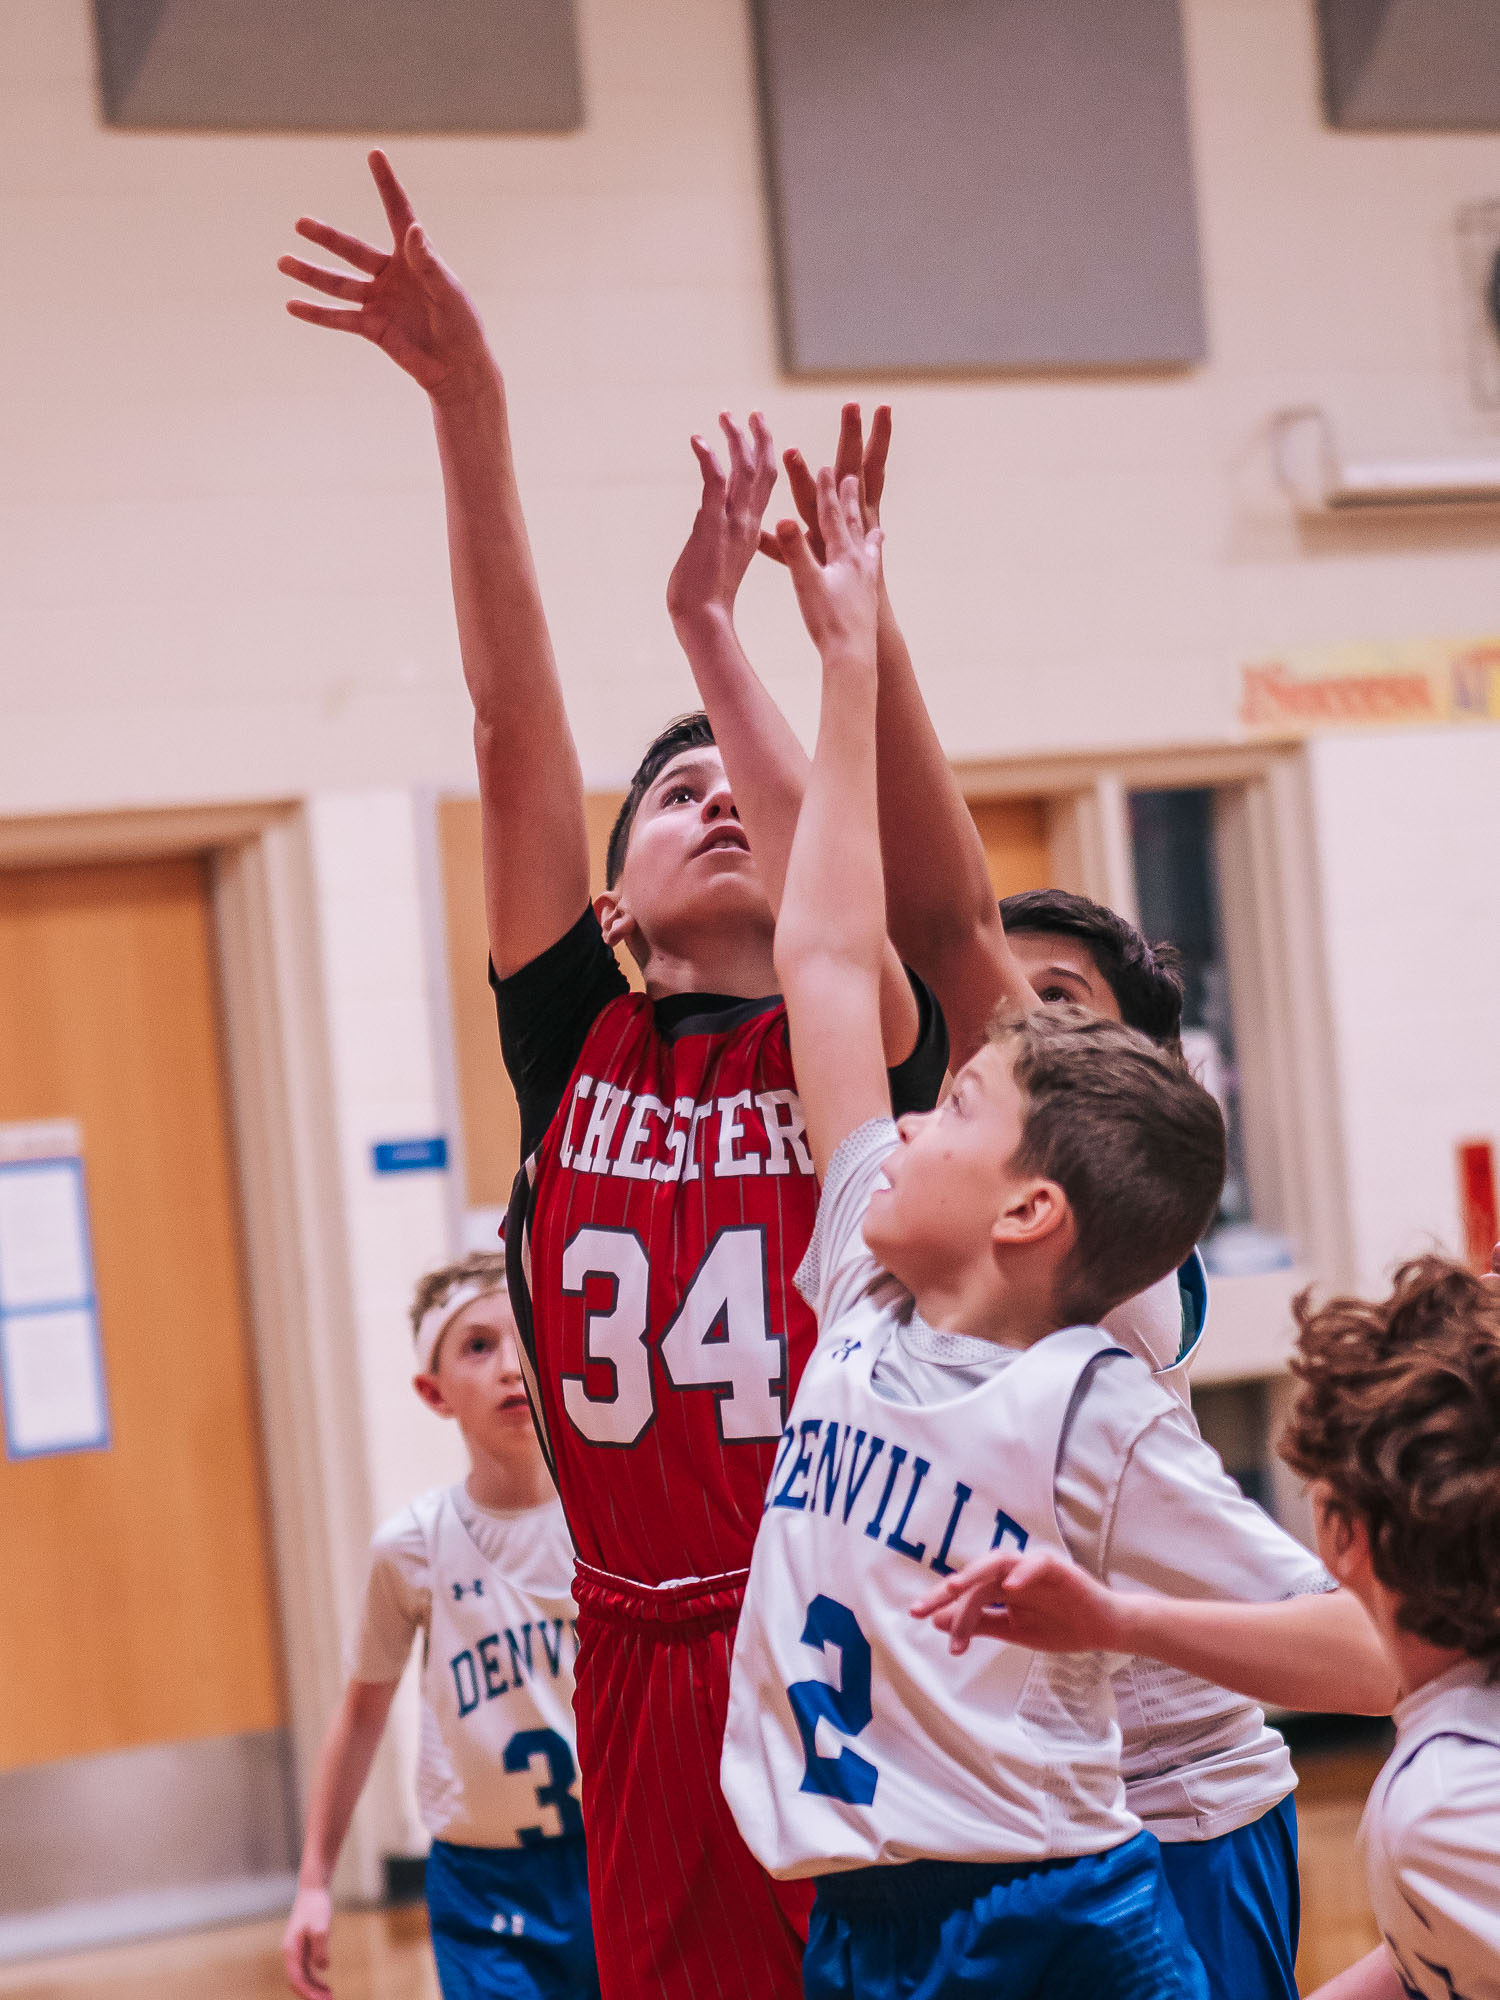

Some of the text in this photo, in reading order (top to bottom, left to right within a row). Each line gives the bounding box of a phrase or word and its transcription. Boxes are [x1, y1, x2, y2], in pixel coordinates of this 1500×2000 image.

[559, 1074, 816, 1183] CHESTER
[560, 1223, 788, 1449] 34
[450, 1616, 580, 1719] DENV
[787, 1593, 879, 1807] 2
[503, 1728, 587, 1850] 3
